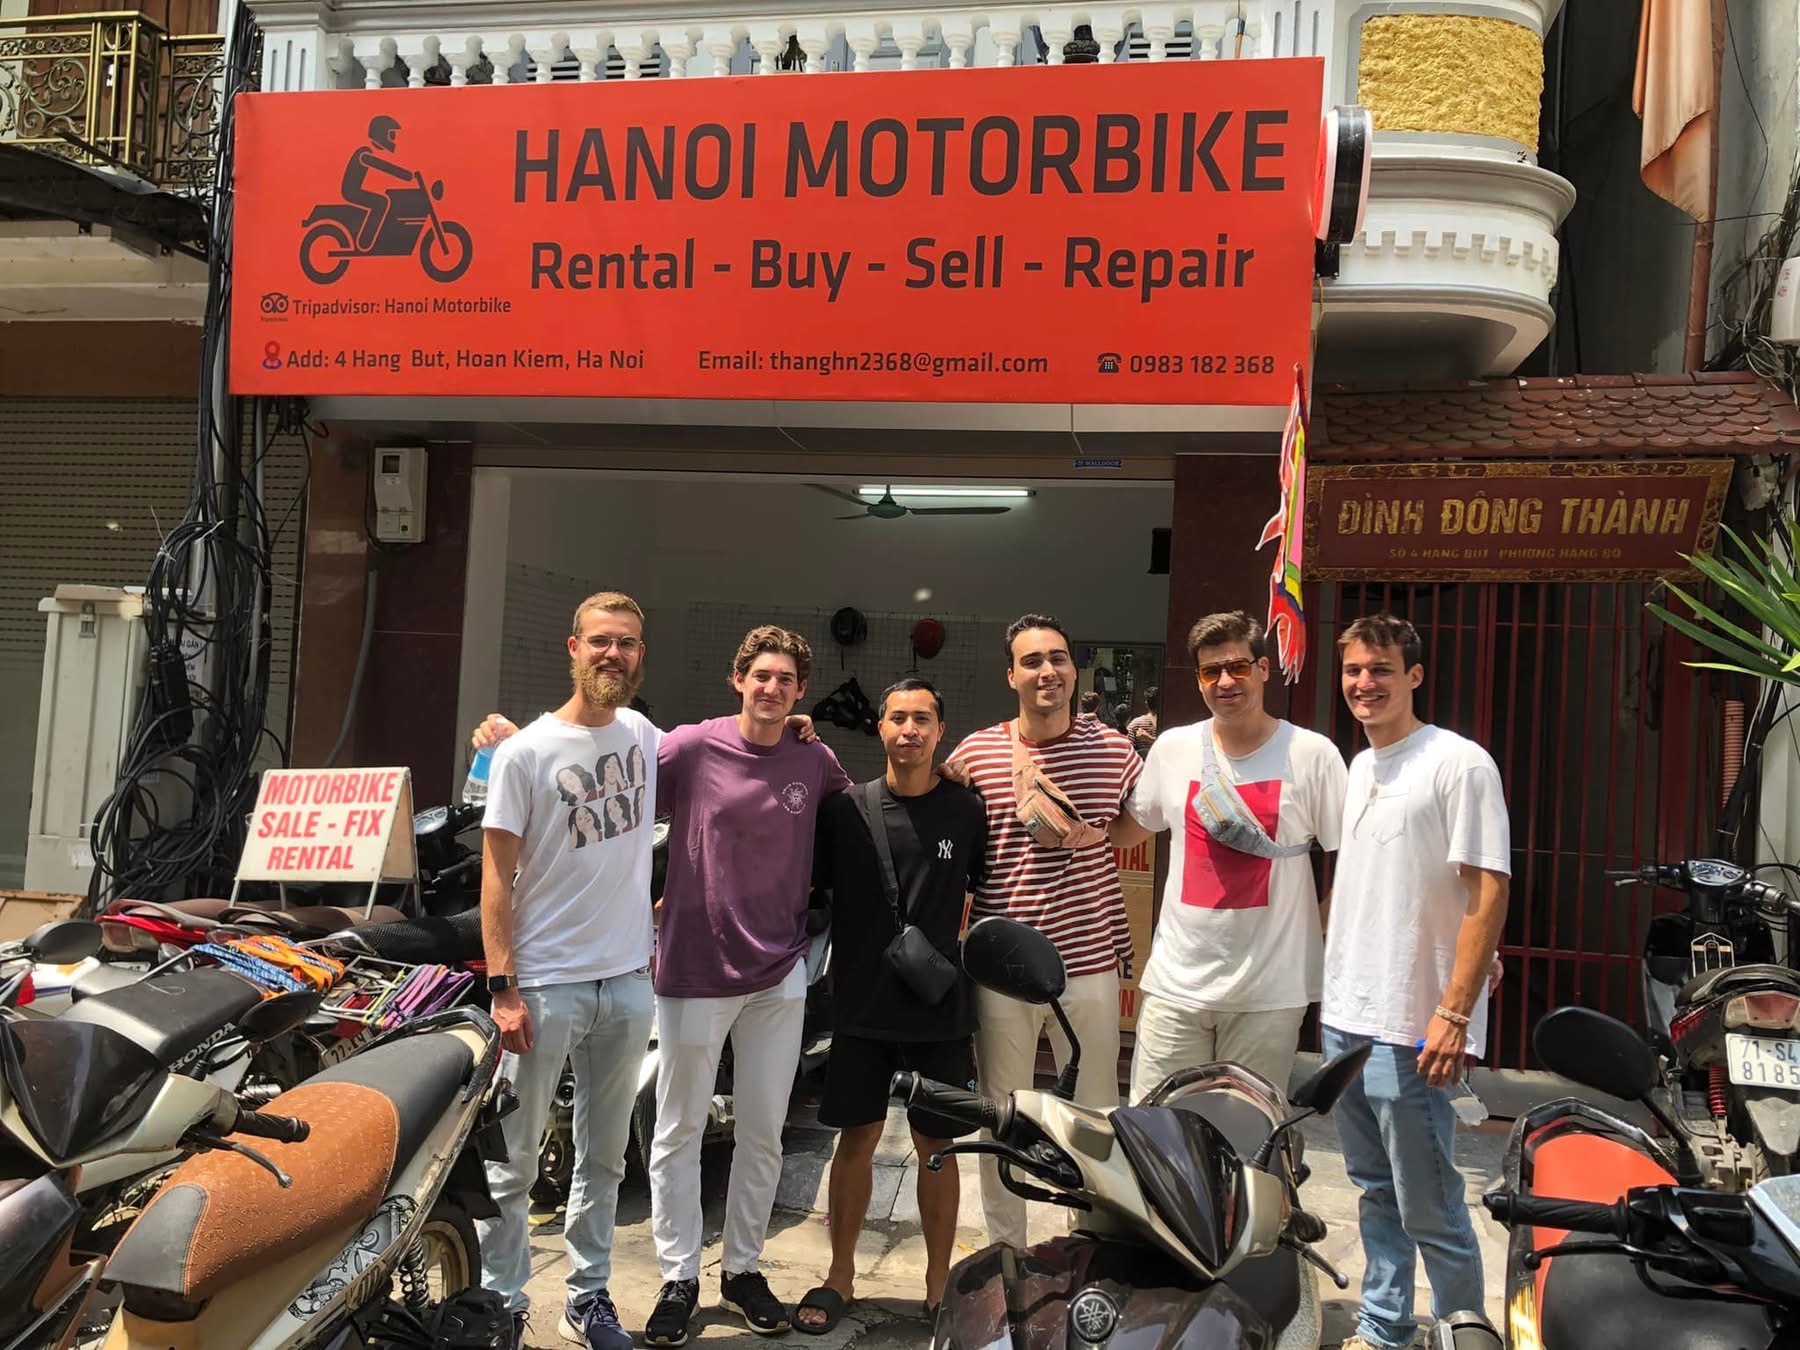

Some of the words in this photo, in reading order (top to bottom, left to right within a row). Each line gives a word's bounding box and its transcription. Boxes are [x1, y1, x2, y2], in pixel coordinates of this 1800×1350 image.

[514, 122, 756, 203] HANOI
[784, 109, 1289, 198] MOTORBIKE
[531, 238, 695, 290] Rental
[714, 263, 731, 273] -
[751, 239, 851, 303] Buy
[867, 262, 886, 272] -
[905, 235, 1004, 289] Sell
[1024, 262, 1043, 271] -
[1064, 233, 1255, 304] Repair
[293, 298, 380, 319] Tripadvisor:
[384, 297, 428, 314] Hanoi
[433, 296, 512, 314] Motorbike
[286, 349, 329, 369] Add:
[334, 350, 348, 368] 4
[353, 349, 401, 373] Hang
[411, 349, 450, 370] But,
[456, 349, 507, 368] Hoan
[513, 348, 570, 371] Kiem,
[576, 349, 604, 369] Ha
[610, 349, 644, 369] Noi
[698, 350, 764, 371] Email:
[769, 351, 1049, 376] thanghn2368@gmail.com
[1129, 354, 1184, 375] 0983
[1190, 354, 1228, 375] 182
[1233, 355, 1275, 375] 368
[263, 772, 399, 805] MOTORBIKE
[258, 811, 321, 838] SALE
[343, 809, 386, 837] FIX
[267, 845, 354, 871] RENTAL
[167, 1021, 237, 1073] HONDA
[1743, 1061, 1800, 1086] 8185
